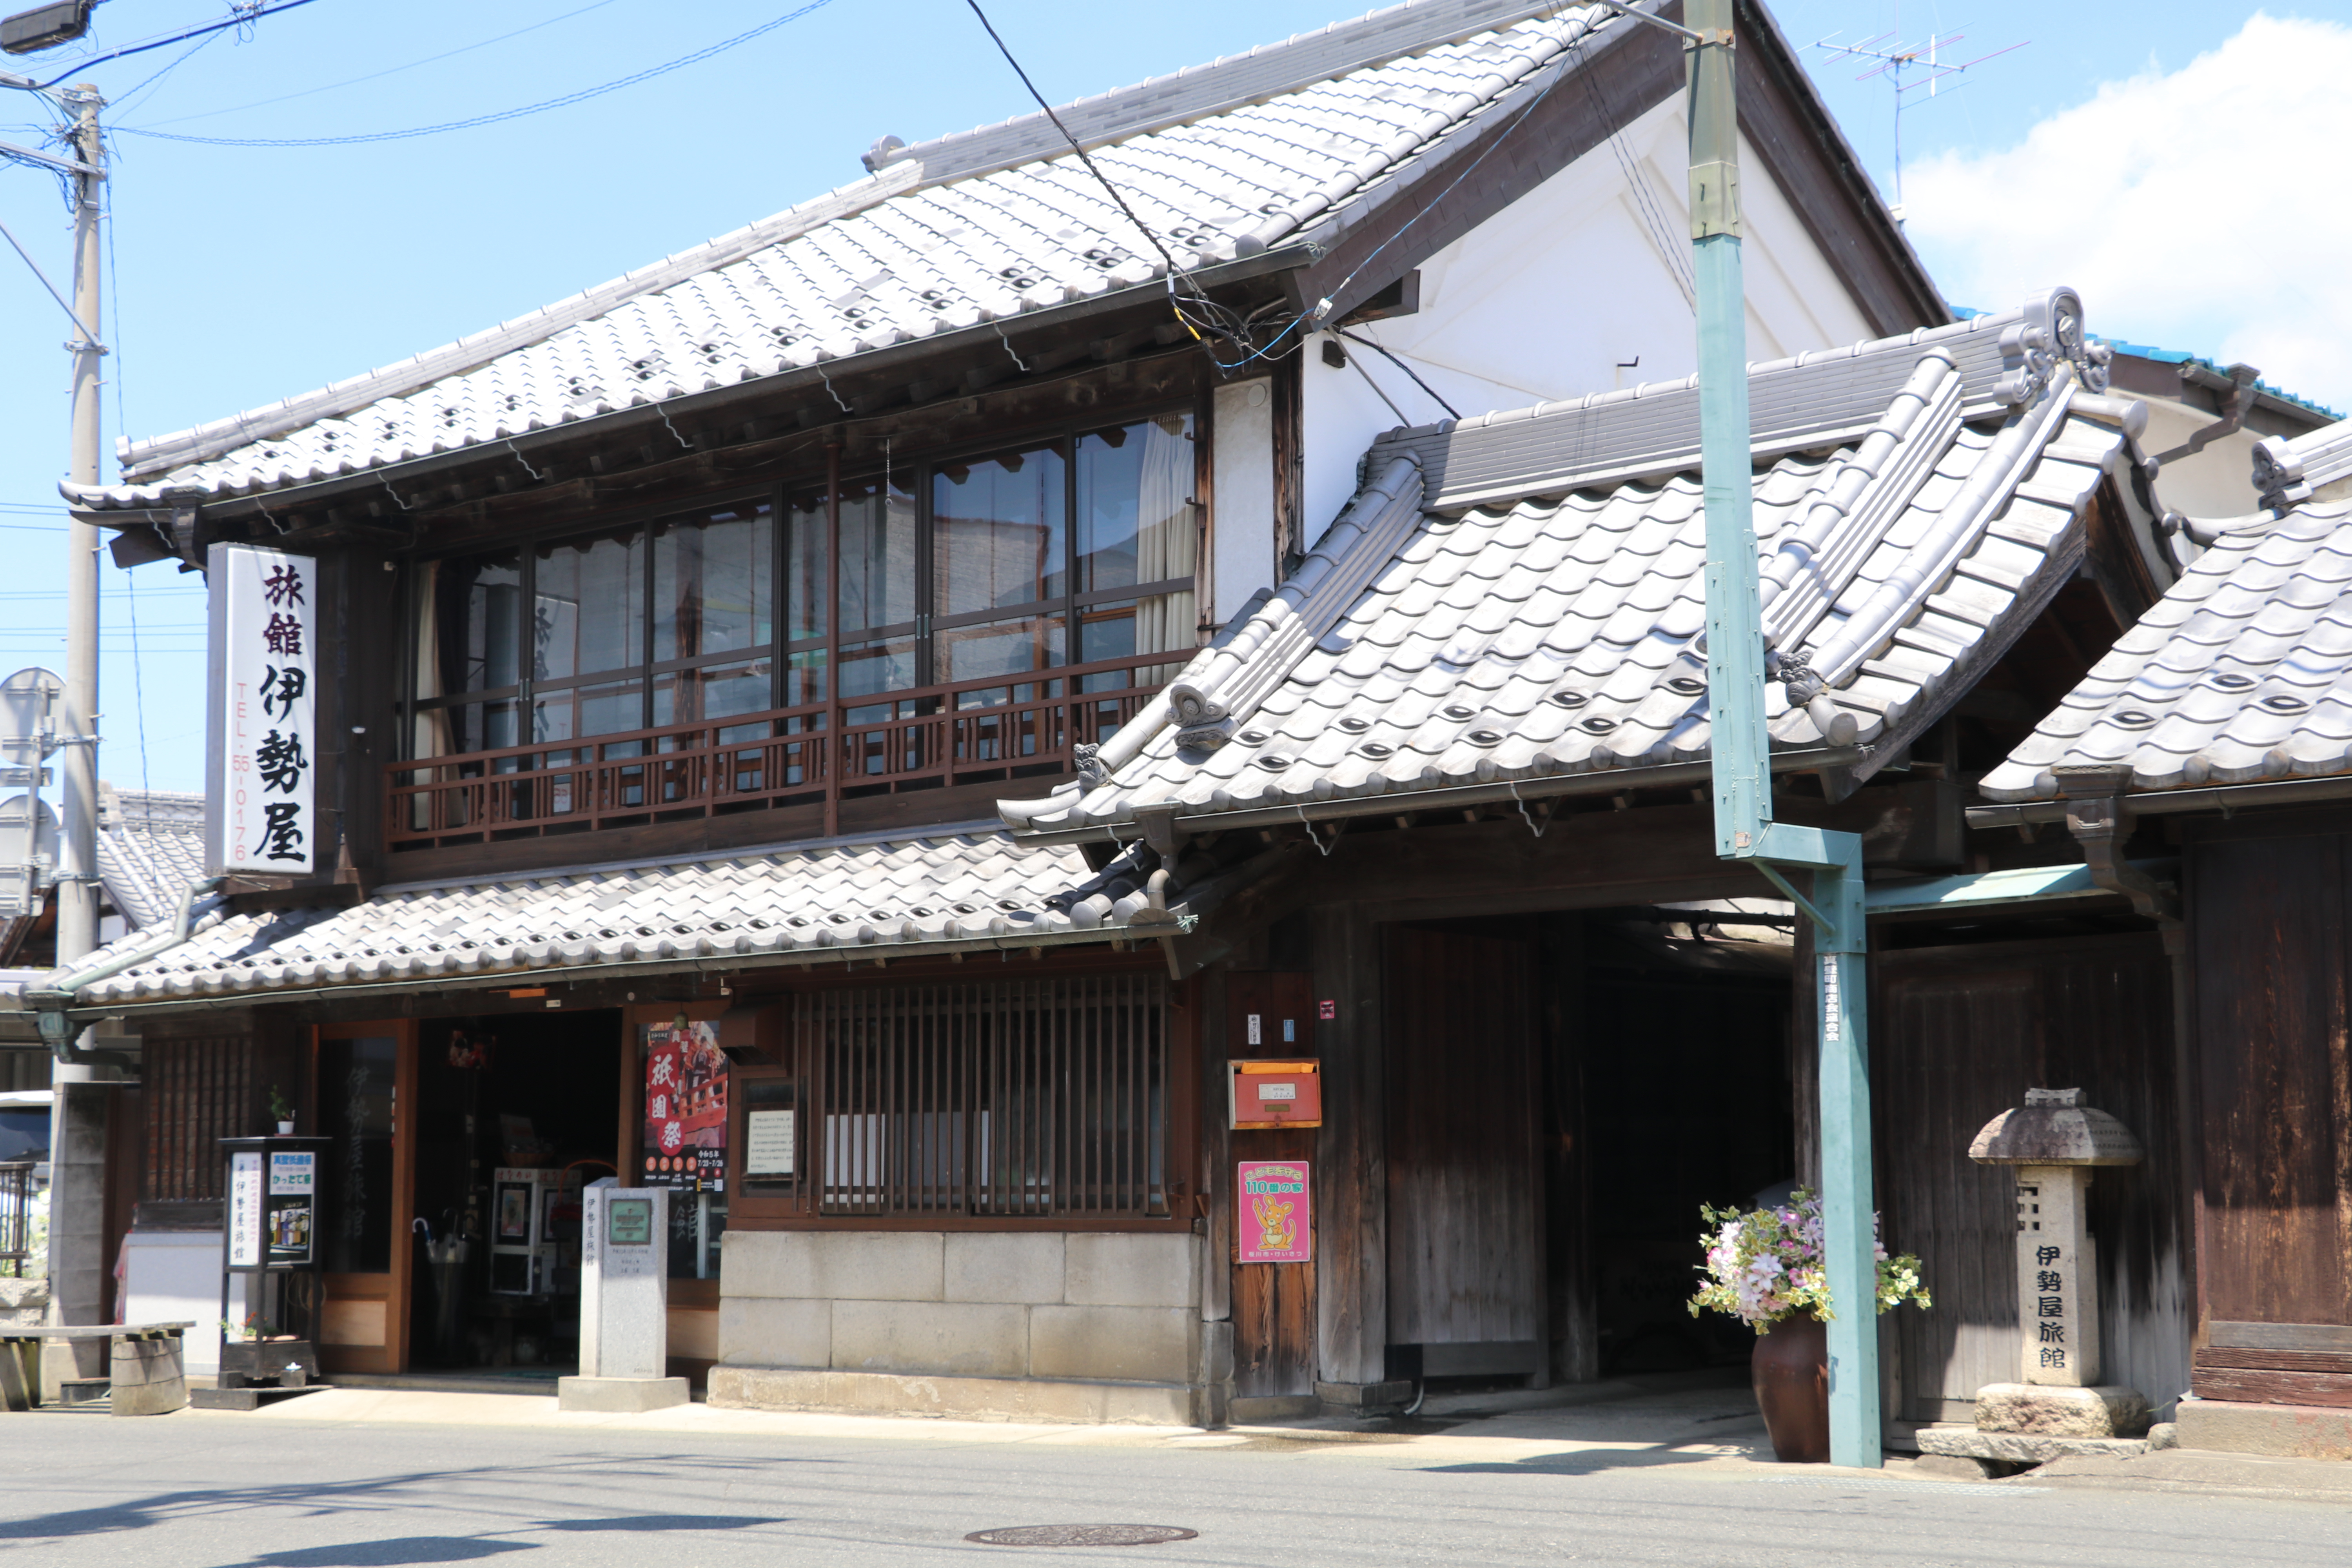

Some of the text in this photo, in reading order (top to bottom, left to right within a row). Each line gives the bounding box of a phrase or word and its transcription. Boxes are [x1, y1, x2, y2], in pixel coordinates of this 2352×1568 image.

[254, 564, 308, 862] 旅館伊勢屋
[1824, 956, 1839, 1041] 真壁町商店会連合会
[698, 1150, 719, 1158] 令和5年
[1245, 1166, 1303, 1180] こどもを守る
[1246, 1181, 1303, 1194] 110番の家
[587, 1198, 596, 1266] 伊勢屋旅館
[2036, 1245, 2065, 1368] 伊勢屋旅館
